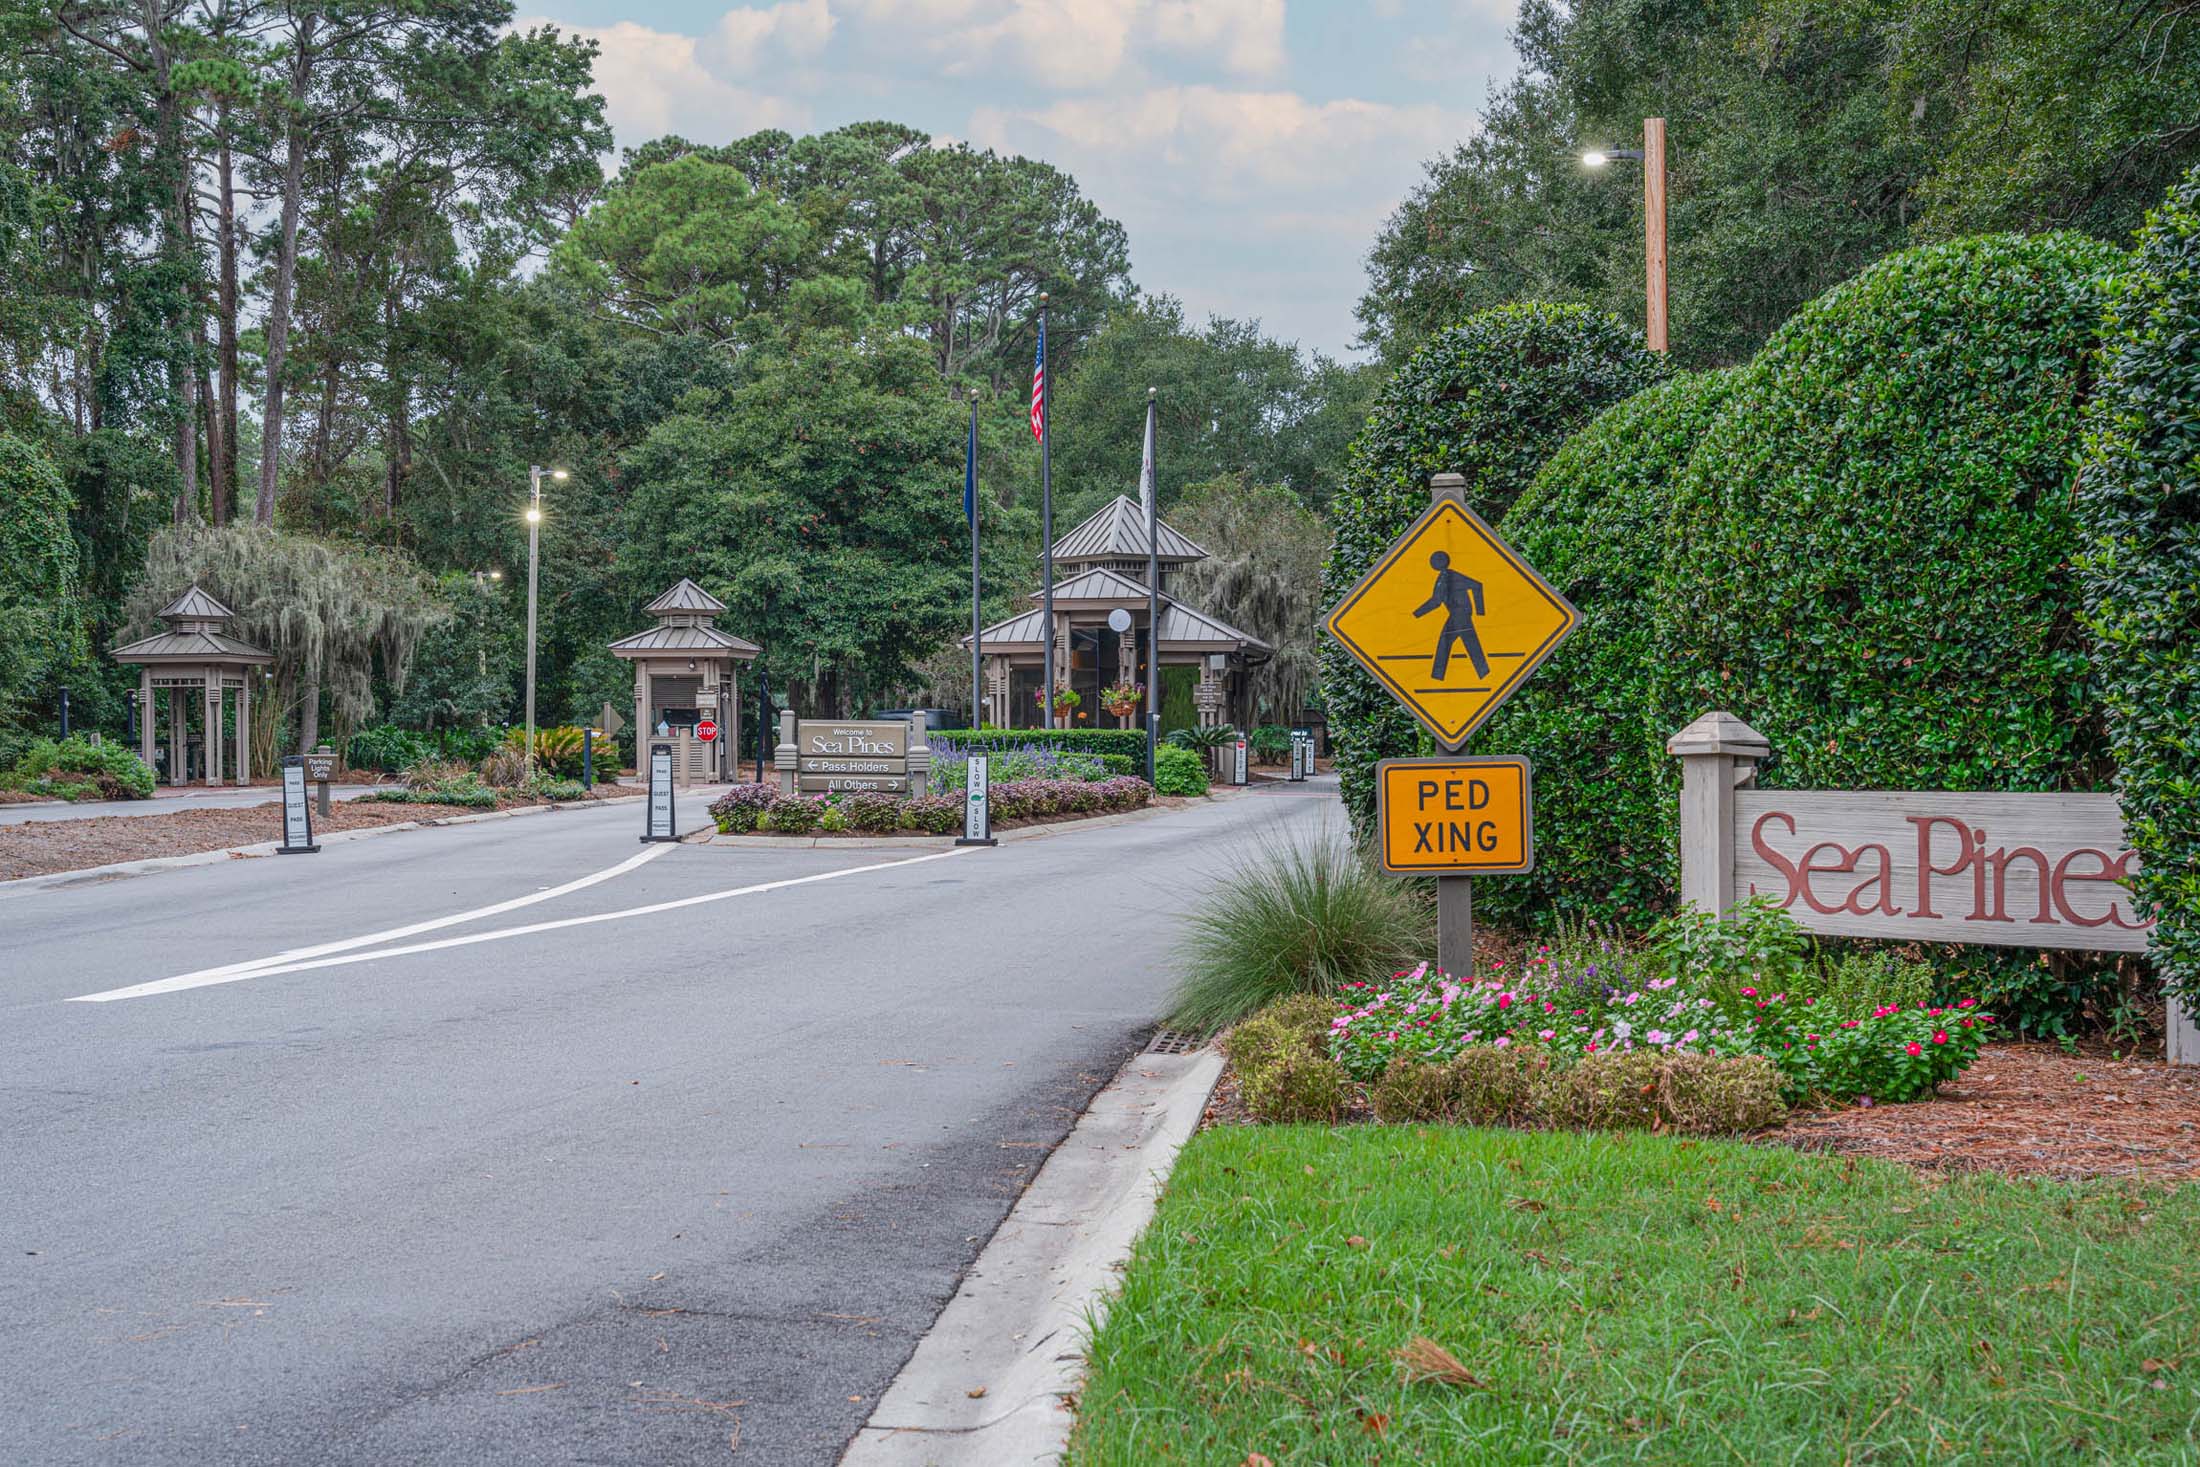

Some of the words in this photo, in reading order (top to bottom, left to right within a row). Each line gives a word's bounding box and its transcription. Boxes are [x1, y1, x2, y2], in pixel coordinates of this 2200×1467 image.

[698, 727, 717, 735] STOP
[833, 728, 865, 736] Welcome
[812, 735, 842, 753] Sea
[848, 736, 894, 754] Pines
[309, 758, 332, 766] Parking
[822, 762, 847, 771] Pass
[850, 762, 889, 772] Holders
[828, 780, 841, 789] All
[844, 780, 878, 790] Others
[1418, 779, 1490, 811] PED
[1414, 821, 1497, 853] XING
[1750, 811, 1903, 916] Sea
